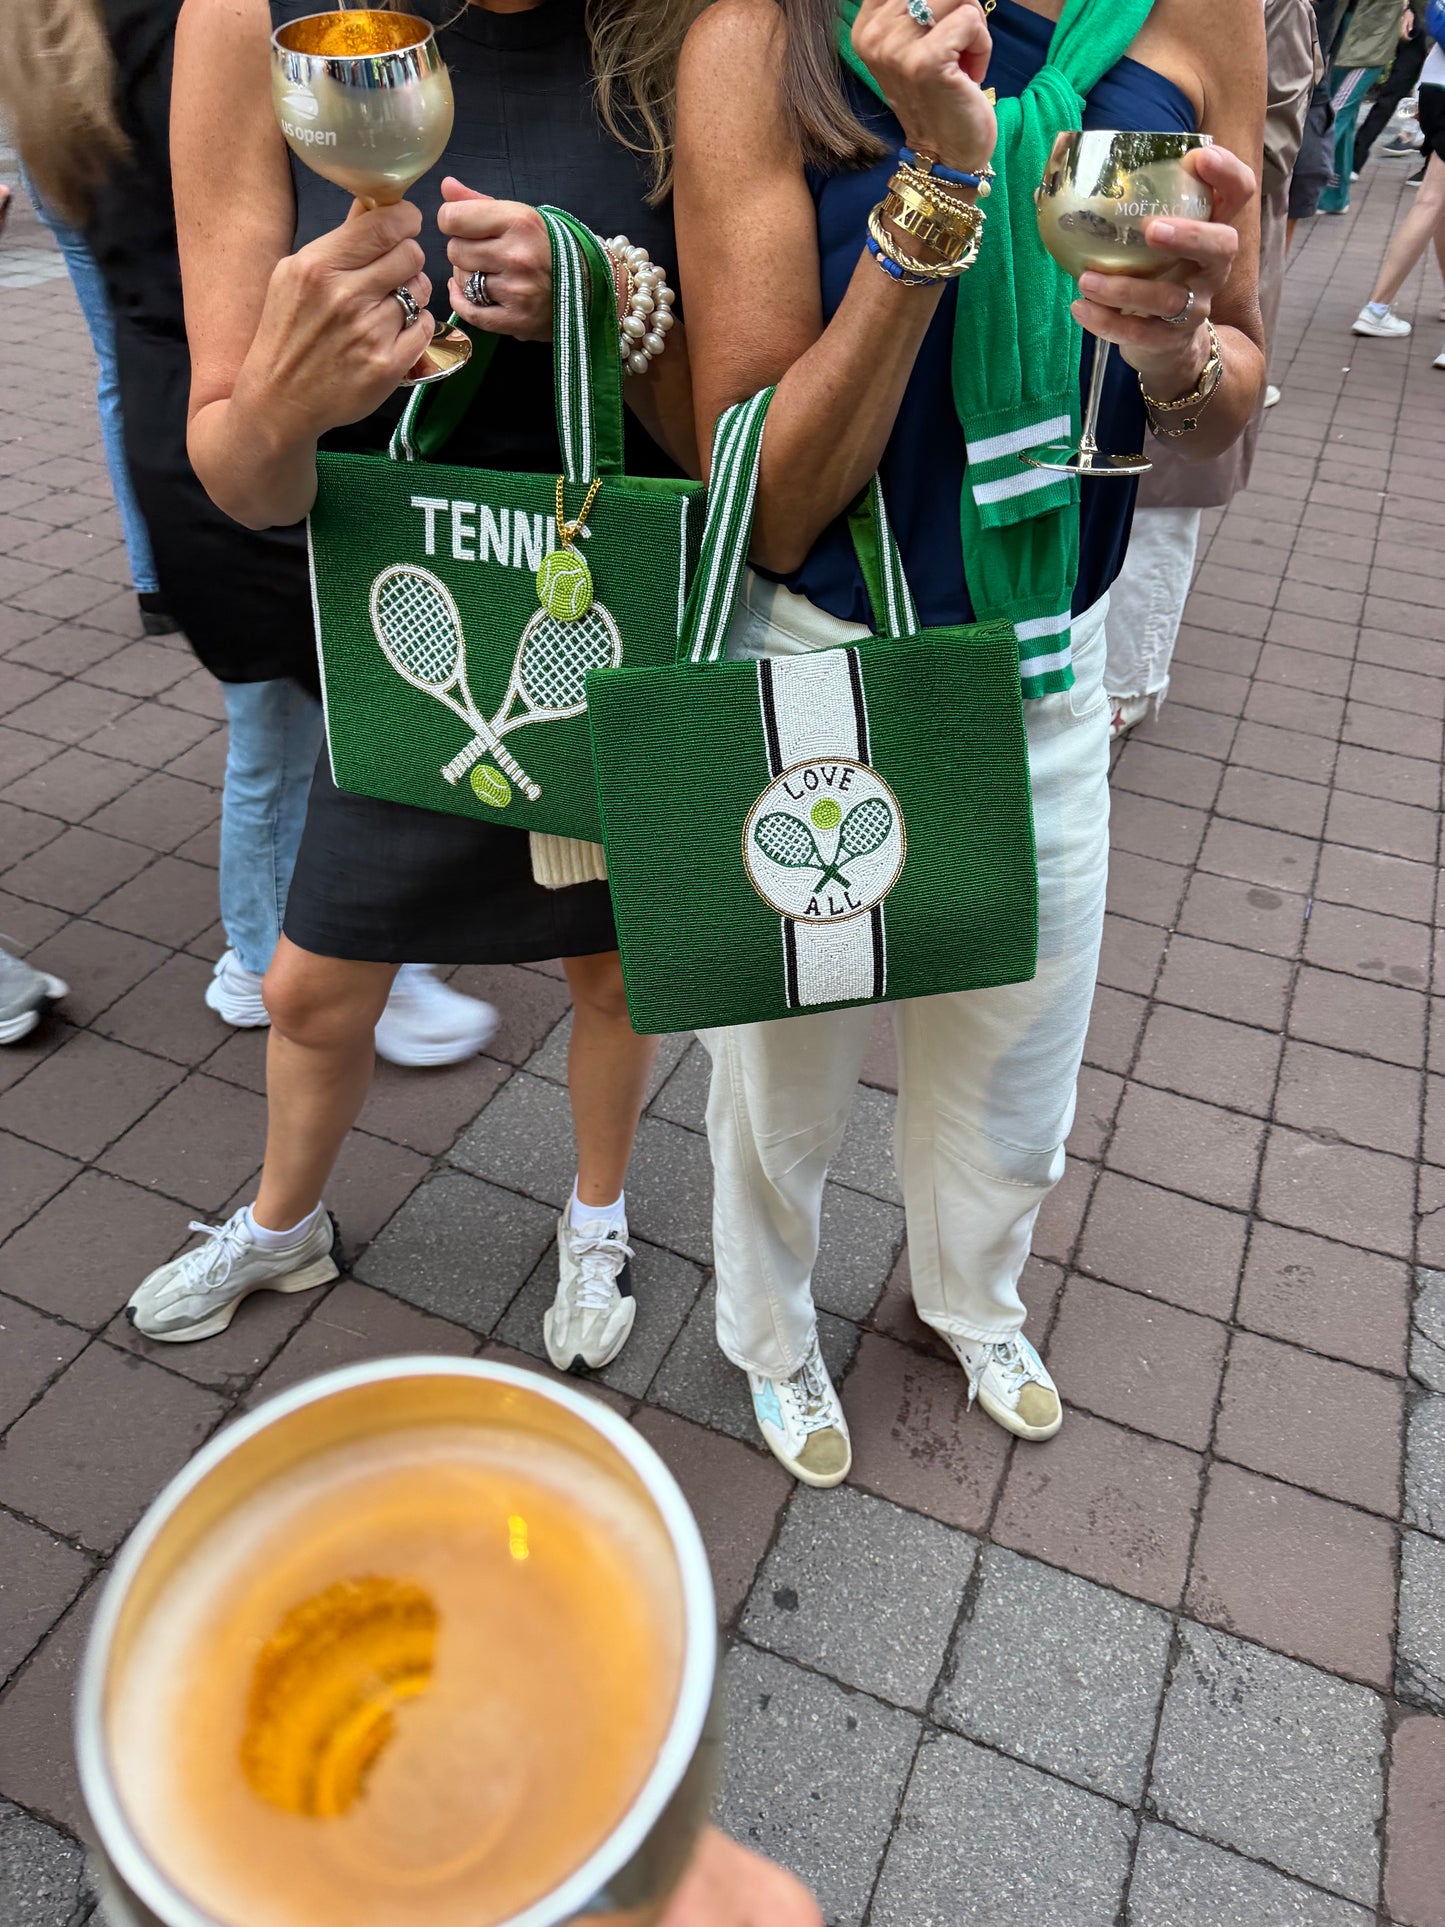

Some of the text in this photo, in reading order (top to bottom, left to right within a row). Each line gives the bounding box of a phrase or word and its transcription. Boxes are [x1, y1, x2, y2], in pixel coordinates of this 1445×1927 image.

[1114, 199, 1160, 217] MOËT
[783, 766, 855, 800] LOVE
[803, 891, 862, 916] ALL
